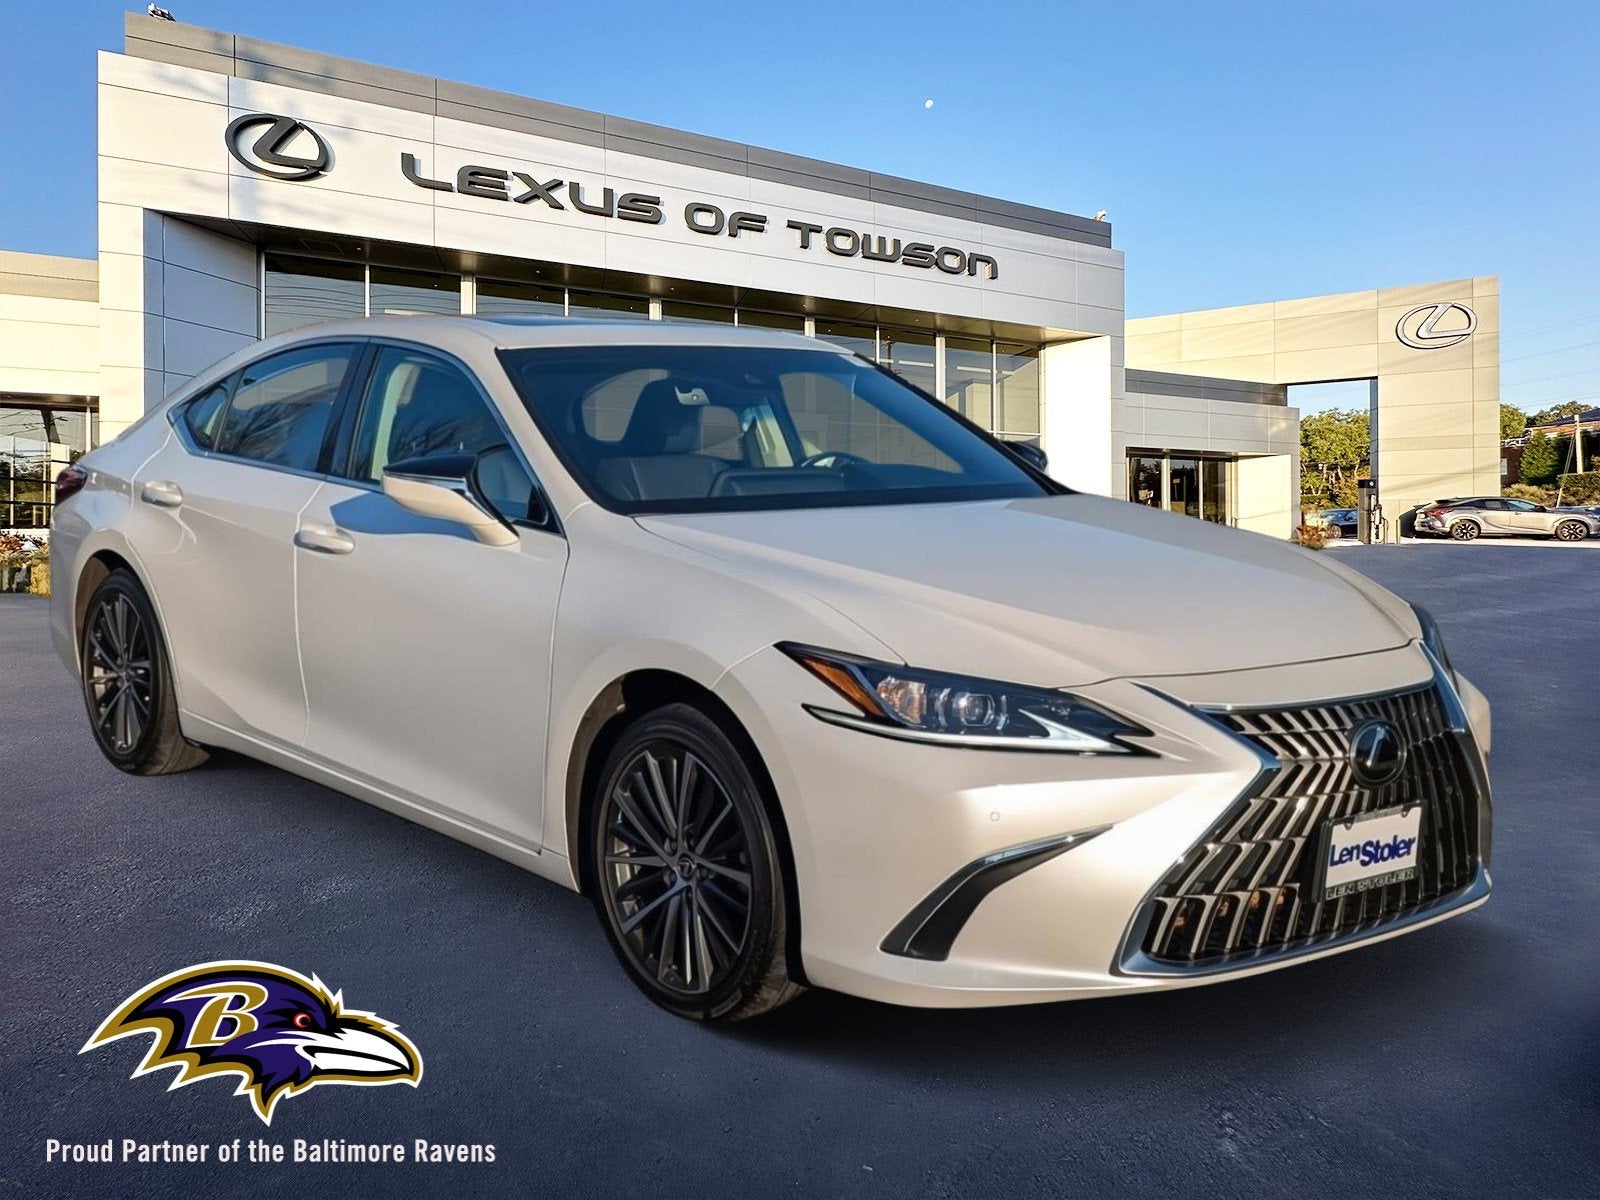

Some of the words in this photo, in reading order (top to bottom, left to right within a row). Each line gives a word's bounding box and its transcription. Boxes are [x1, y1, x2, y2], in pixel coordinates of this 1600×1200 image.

[401, 152, 662, 225] LEXUS
[684, 201, 768, 238] OF
[786, 219, 998, 280] TOWSON
